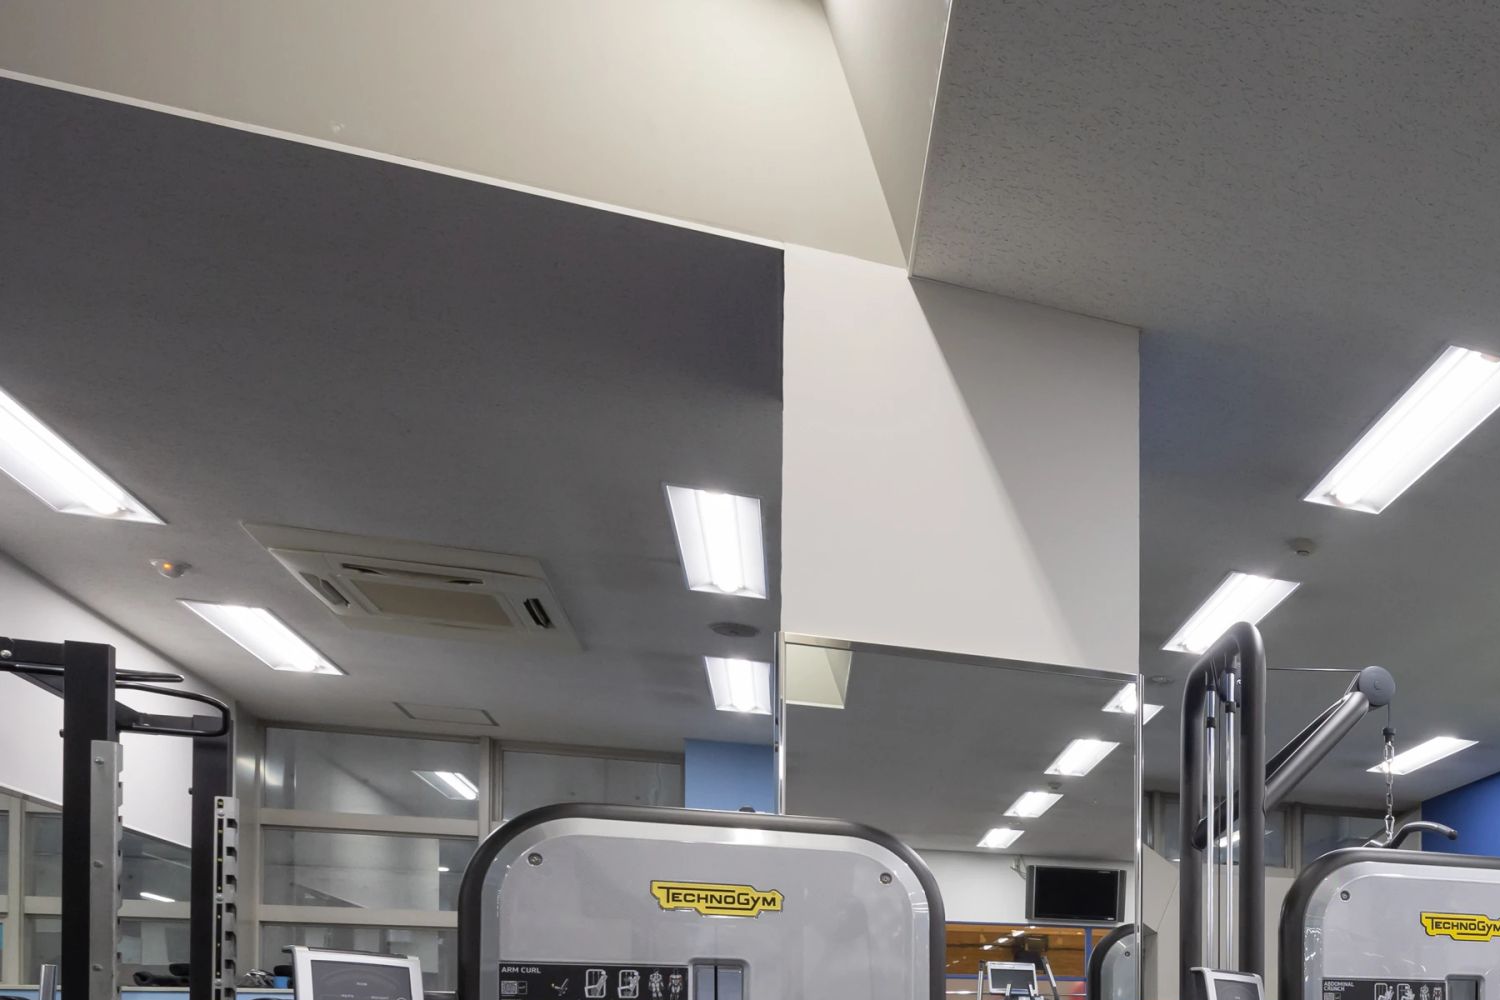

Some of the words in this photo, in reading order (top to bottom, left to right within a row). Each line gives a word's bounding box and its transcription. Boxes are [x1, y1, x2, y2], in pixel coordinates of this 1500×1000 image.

[657, 886, 777, 911] TECHNOGYM
[501, 966, 519, 974] ARM
[520, 966, 541, 974] CURL
